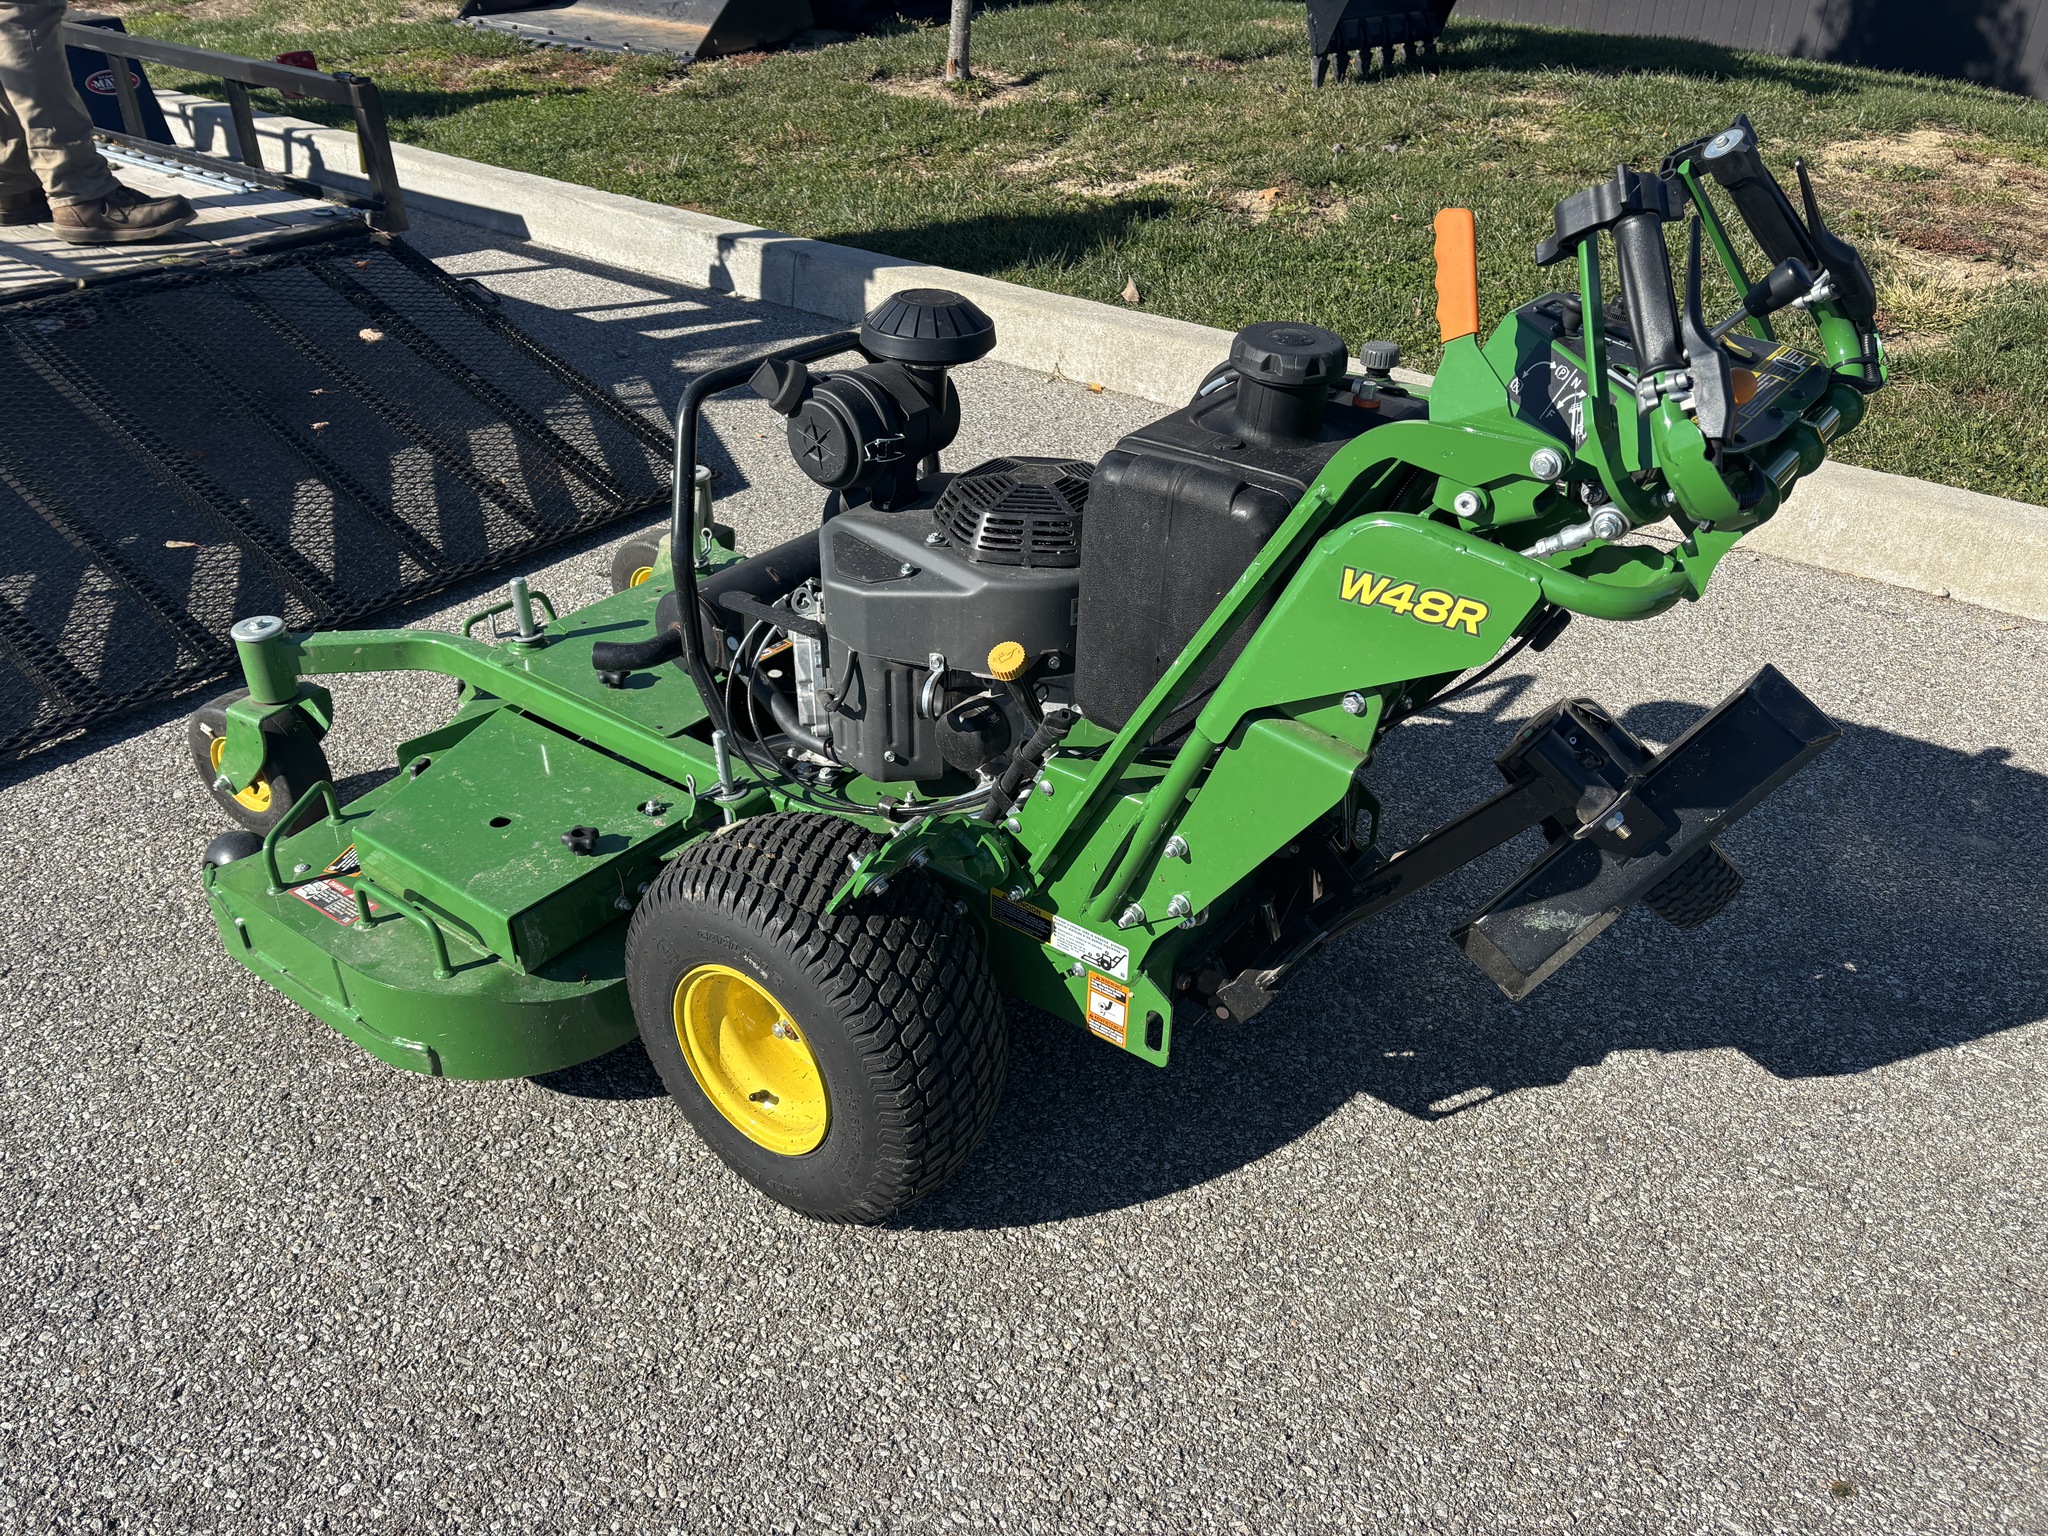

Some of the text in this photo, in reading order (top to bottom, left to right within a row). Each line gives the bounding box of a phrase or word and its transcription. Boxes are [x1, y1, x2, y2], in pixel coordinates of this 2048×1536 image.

[1571, 377, 1581, 389] N
[1546, 409, 1555, 418] F
[1339, 565, 1490, 637] W48R
